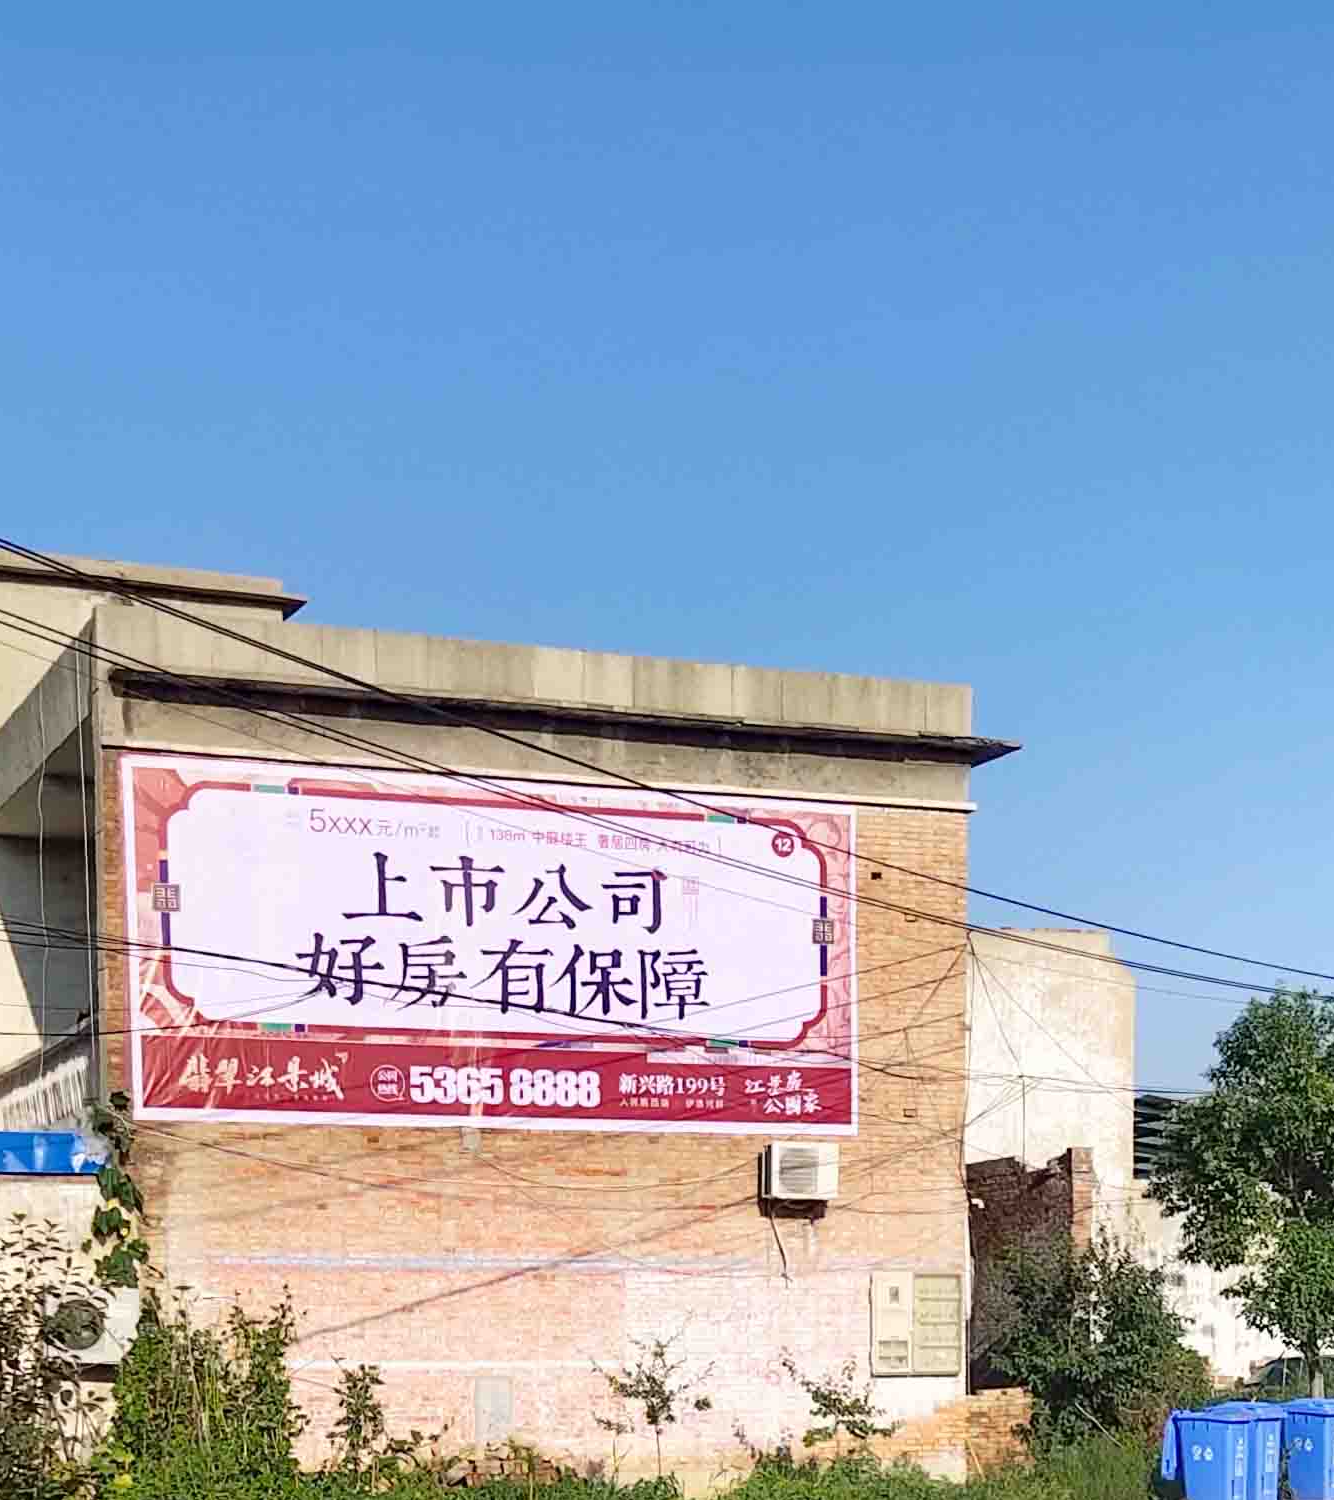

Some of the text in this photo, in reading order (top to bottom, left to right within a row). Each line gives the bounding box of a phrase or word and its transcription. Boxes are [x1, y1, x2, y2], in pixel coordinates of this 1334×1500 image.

[342, 852, 667, 934] 上市公司
[296, 932, 711, 1020] 好房有保障
[410, 1066, 504, 1105] 5365
[509, 1068, 601, 1108] 8888
[618, 1073, 726, 1096] 新兴路199号
